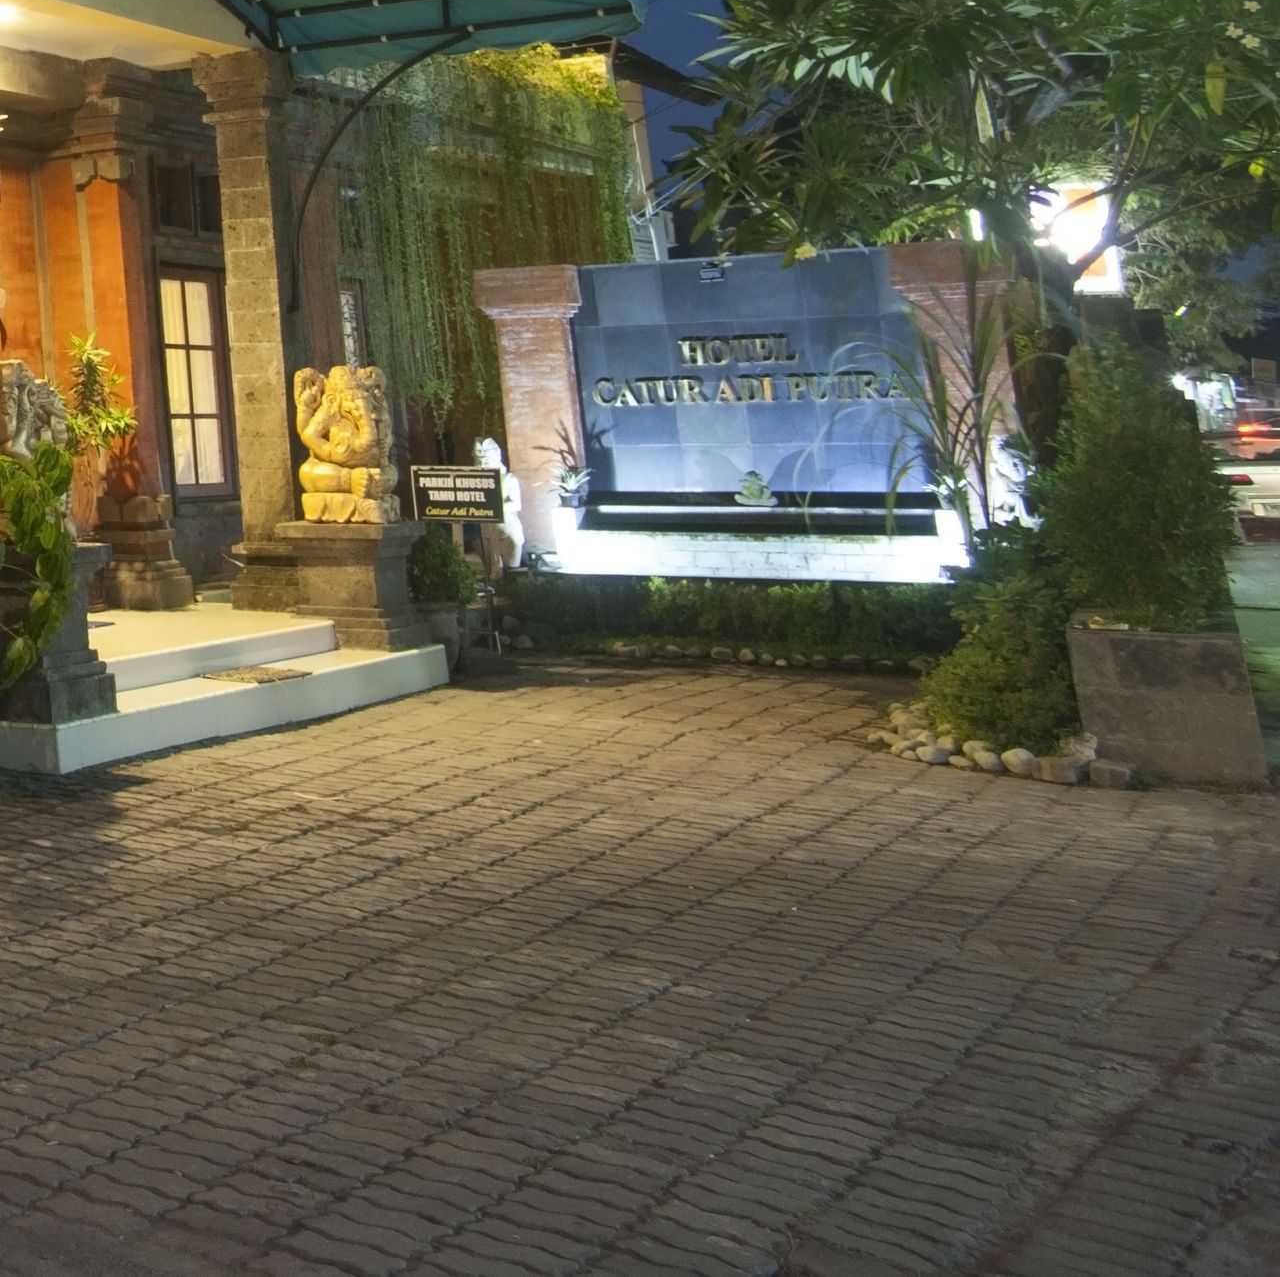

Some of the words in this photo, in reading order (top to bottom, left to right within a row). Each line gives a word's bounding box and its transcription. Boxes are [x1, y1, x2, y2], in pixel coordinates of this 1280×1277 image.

[678, 334, 799, 366] HOTEL
[592, 375, 710, 407] CATUR
[714, 373, 777, 403] ADI
[786, 370, 915, 403] PUTRA
[419, 475, 454, 488] PARKIR
[455, 477, 495, 489] KHUSUS
[428, 490, 455, 501] TAMU
[456, 491, 486, 502] HOTEL
[450, 507, 467, 516] Adi
[468, 507, 494, 517] Putra
